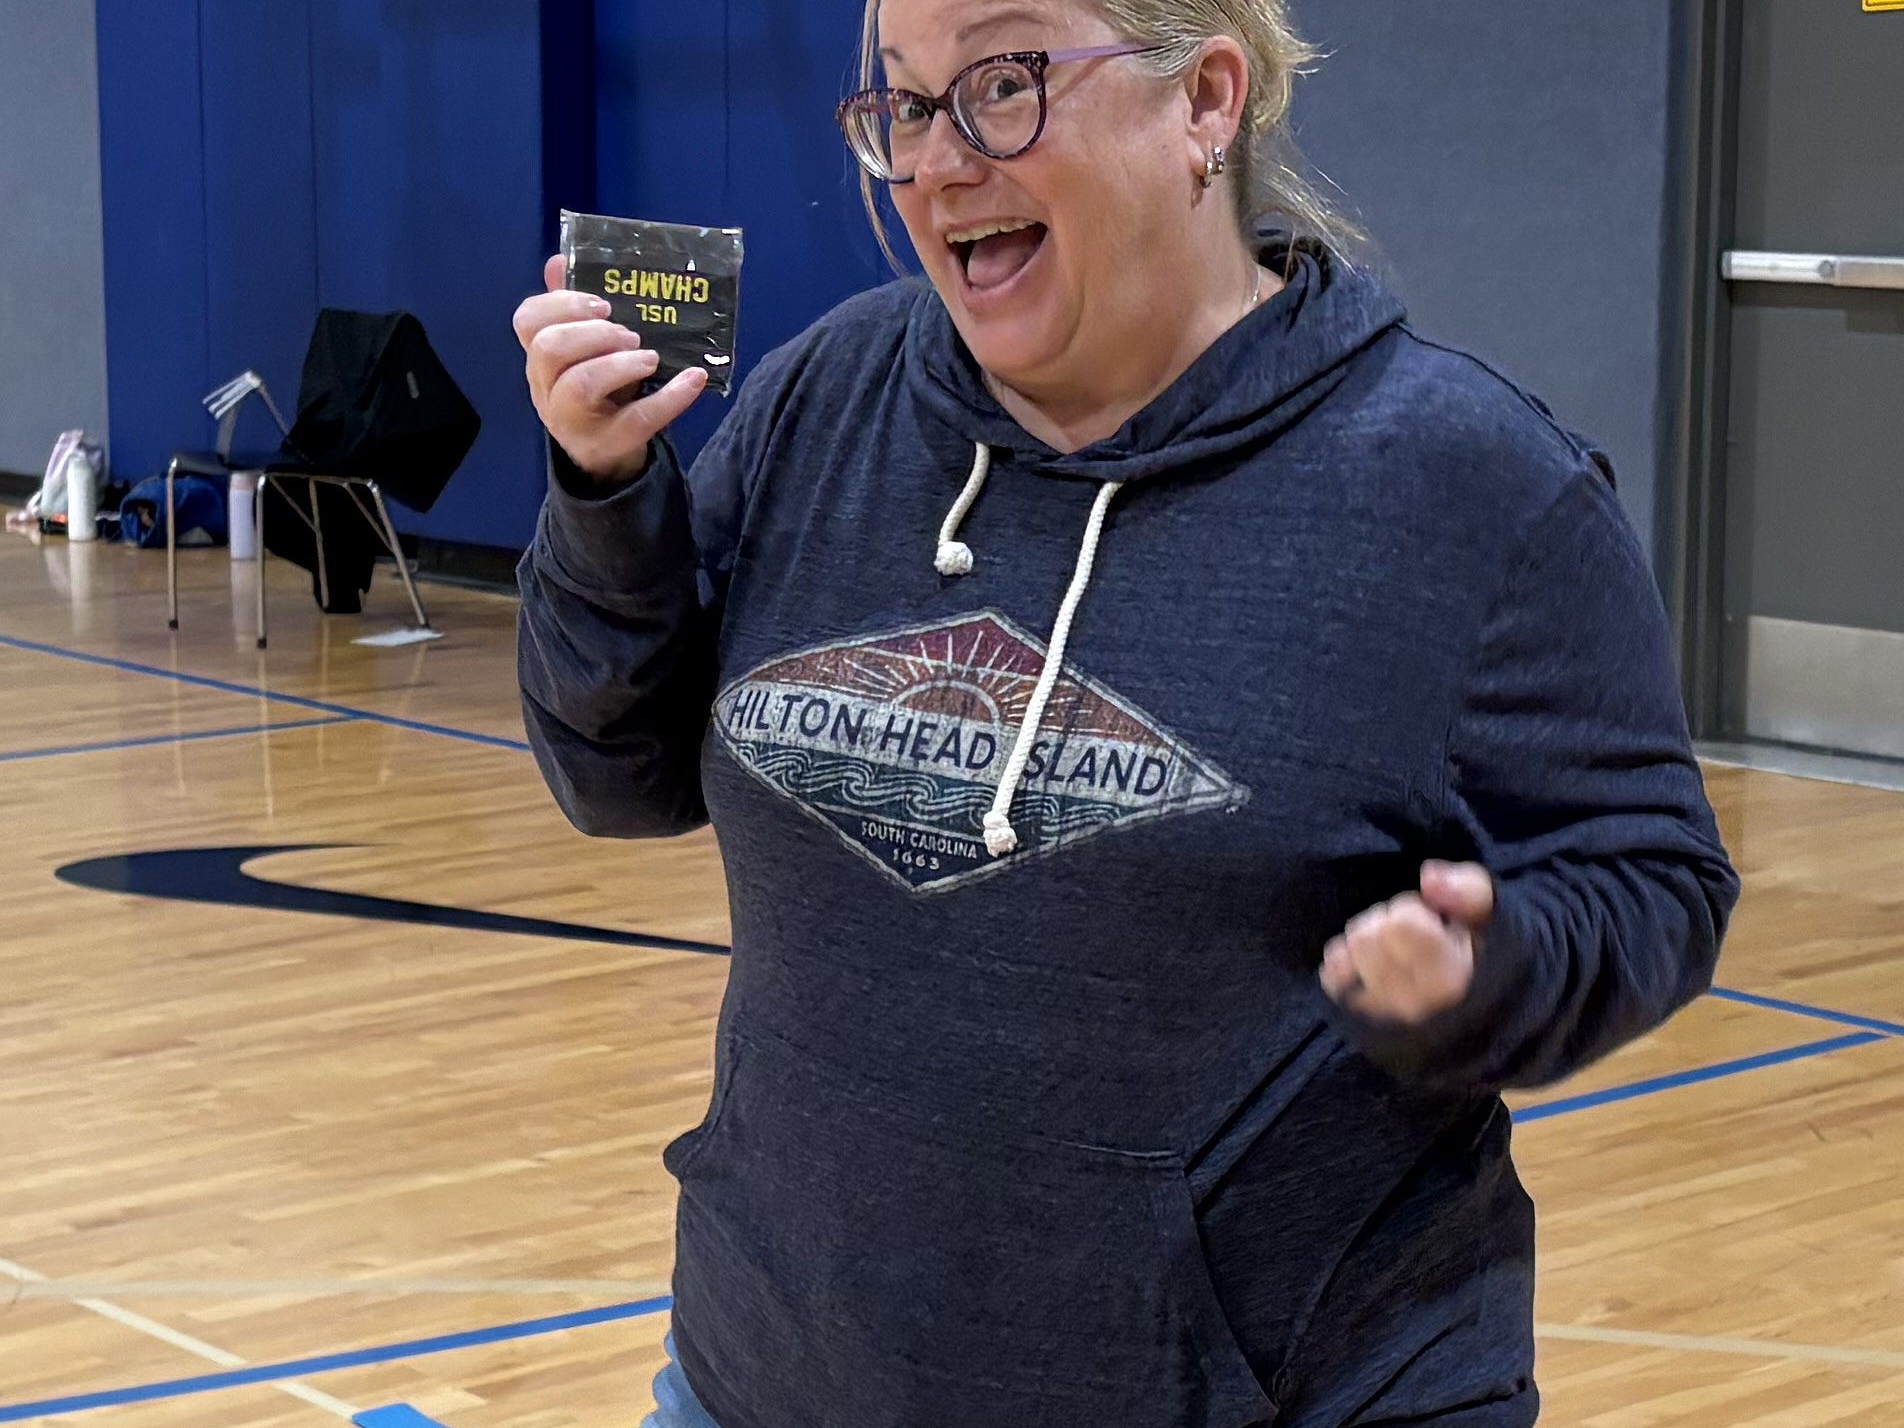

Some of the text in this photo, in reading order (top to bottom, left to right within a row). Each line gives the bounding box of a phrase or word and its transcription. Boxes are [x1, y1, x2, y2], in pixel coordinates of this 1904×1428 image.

[604, 269, 709, 303] CHAMPS
[636, 304, 677, 324] USL
[728, 689, 1168, 797] HILTON HEAD SLAND
[861, 821, 978, 859] SOUTH CAROLINA
[892, 848, 940, 871] 1663
